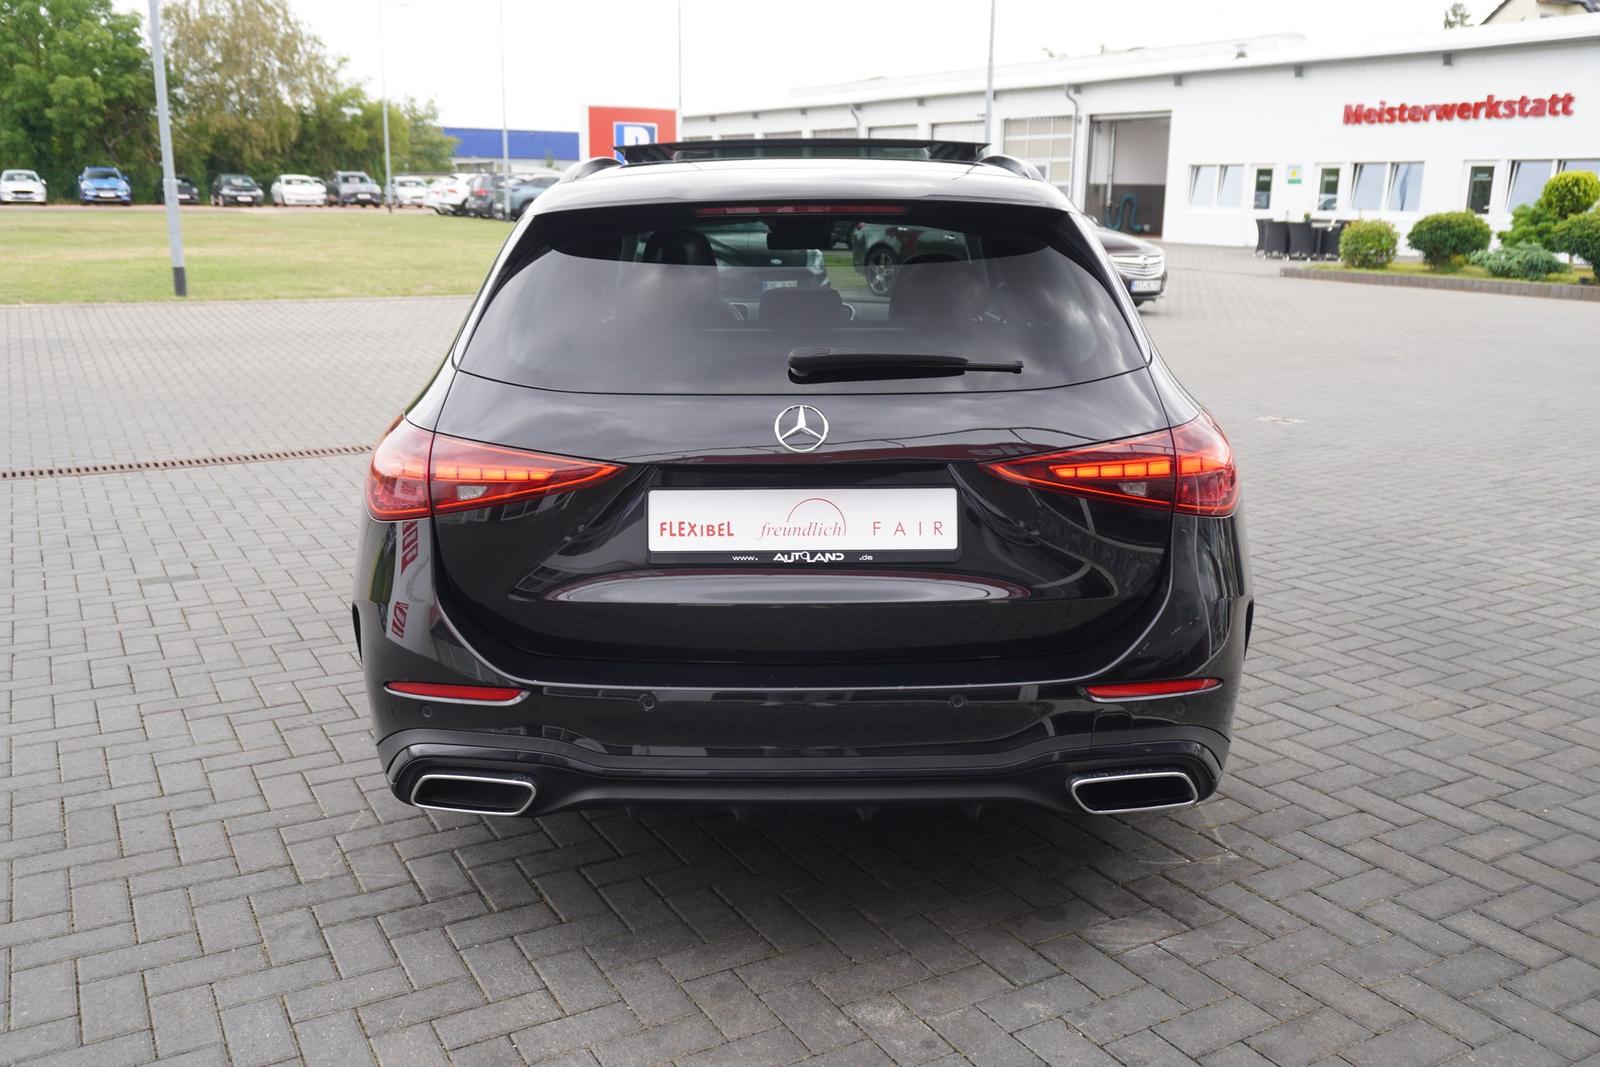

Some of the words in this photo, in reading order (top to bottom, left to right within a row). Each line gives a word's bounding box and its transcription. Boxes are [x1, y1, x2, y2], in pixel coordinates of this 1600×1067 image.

[1343, 93, 1575, 125] Meisterwerkstatt
[659, 520, 735, 537] FLEXIBEL
[758, 521, 843, 540] freundlich
[772, 551, 845, 563] AUTOLAND
